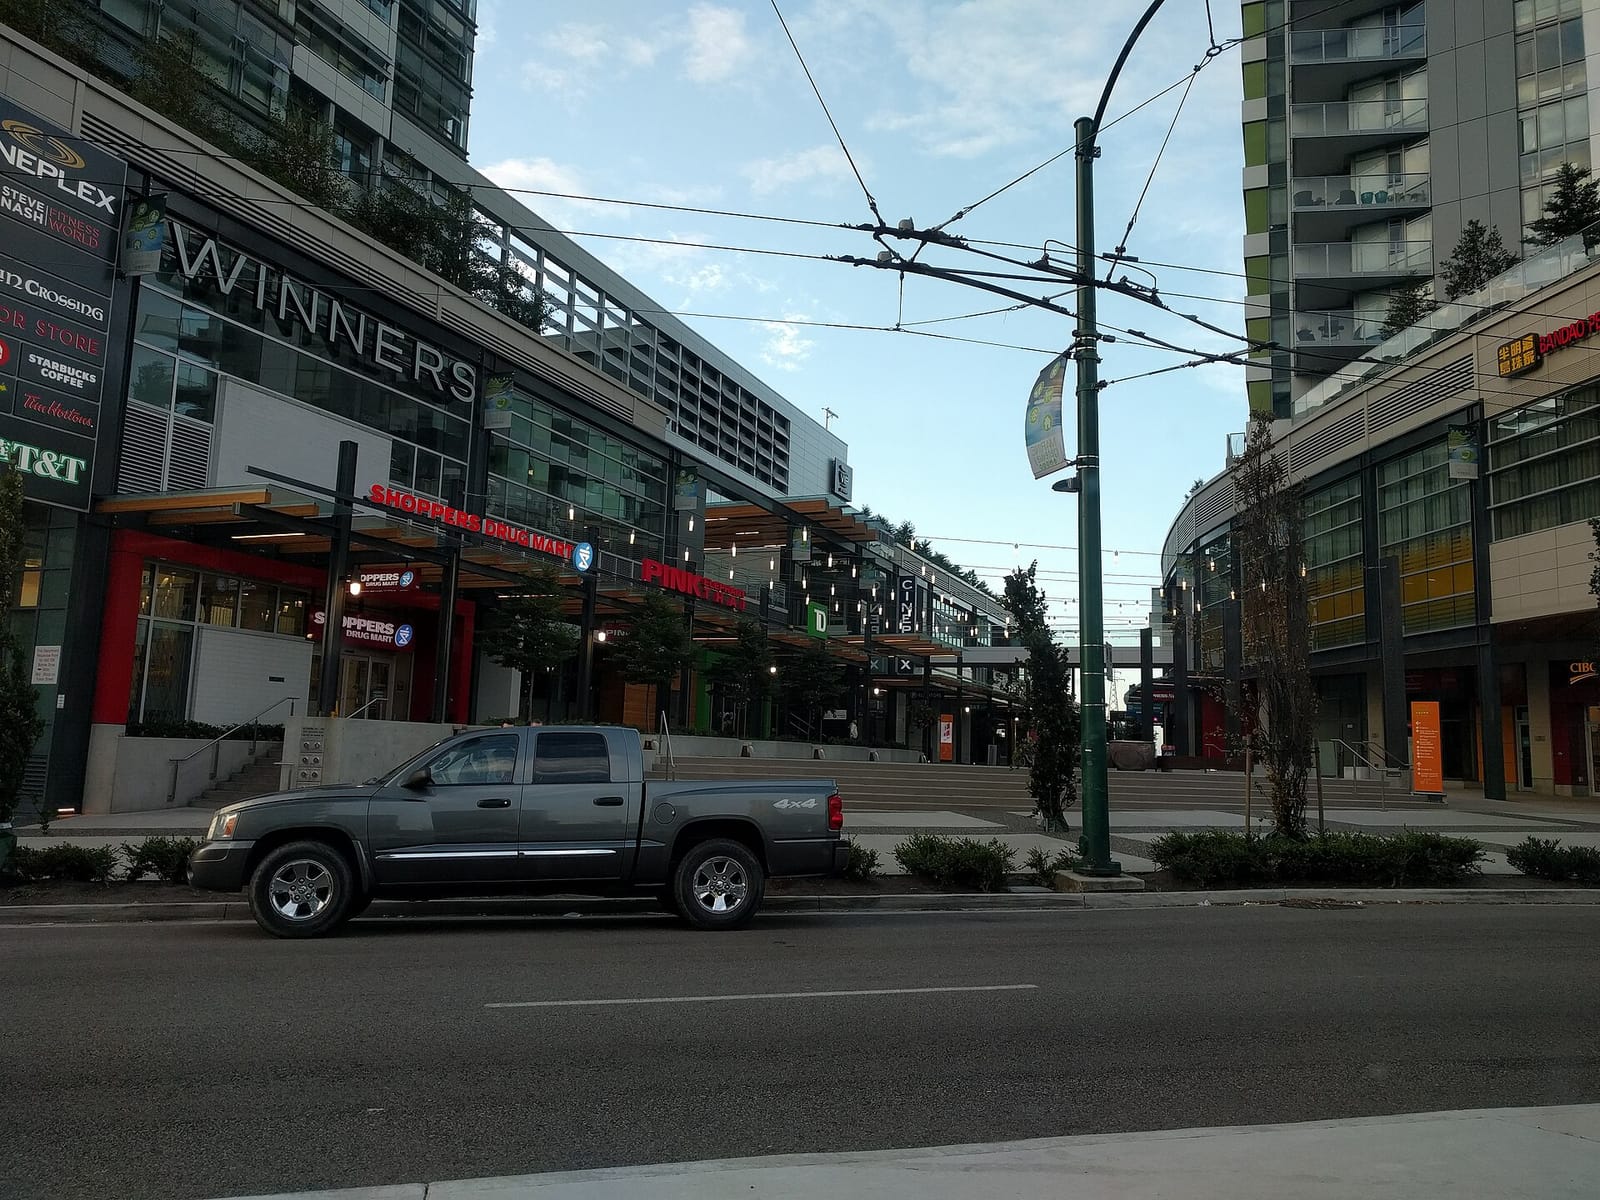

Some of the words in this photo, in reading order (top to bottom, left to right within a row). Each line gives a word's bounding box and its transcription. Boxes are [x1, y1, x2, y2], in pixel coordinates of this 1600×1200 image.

[1, 196, 44, 225] NASH
[2, 185, 45, 213] STEVE
[49, 219, 99, 249] WORLD
[50, 207, 100, 238] FITNESS
[171, 221, 476, 403] WINNERS
[35, 319, 99, 356] STORE
[1540, 319, 1585, 354] BANDAO
[28, 353, 97, 383] STARBUCKS
[41, 368, 84, 389] COFFEE
[23, 392, 47, 414] Tim
[11, 441, 86, 484] T&T
[368, 484, 481, 533] SHOPPERS
[482, 518, 530, 546] DRUG
[530, 533, 575, 559] MART
[642, 557, 702, 598] PINK
[813, 608, 827, 633] TD
[346, 629, 370, 640] DRUG
[370, 632, 394, 643] MART
[773, 798, 818, 809] 4x4
